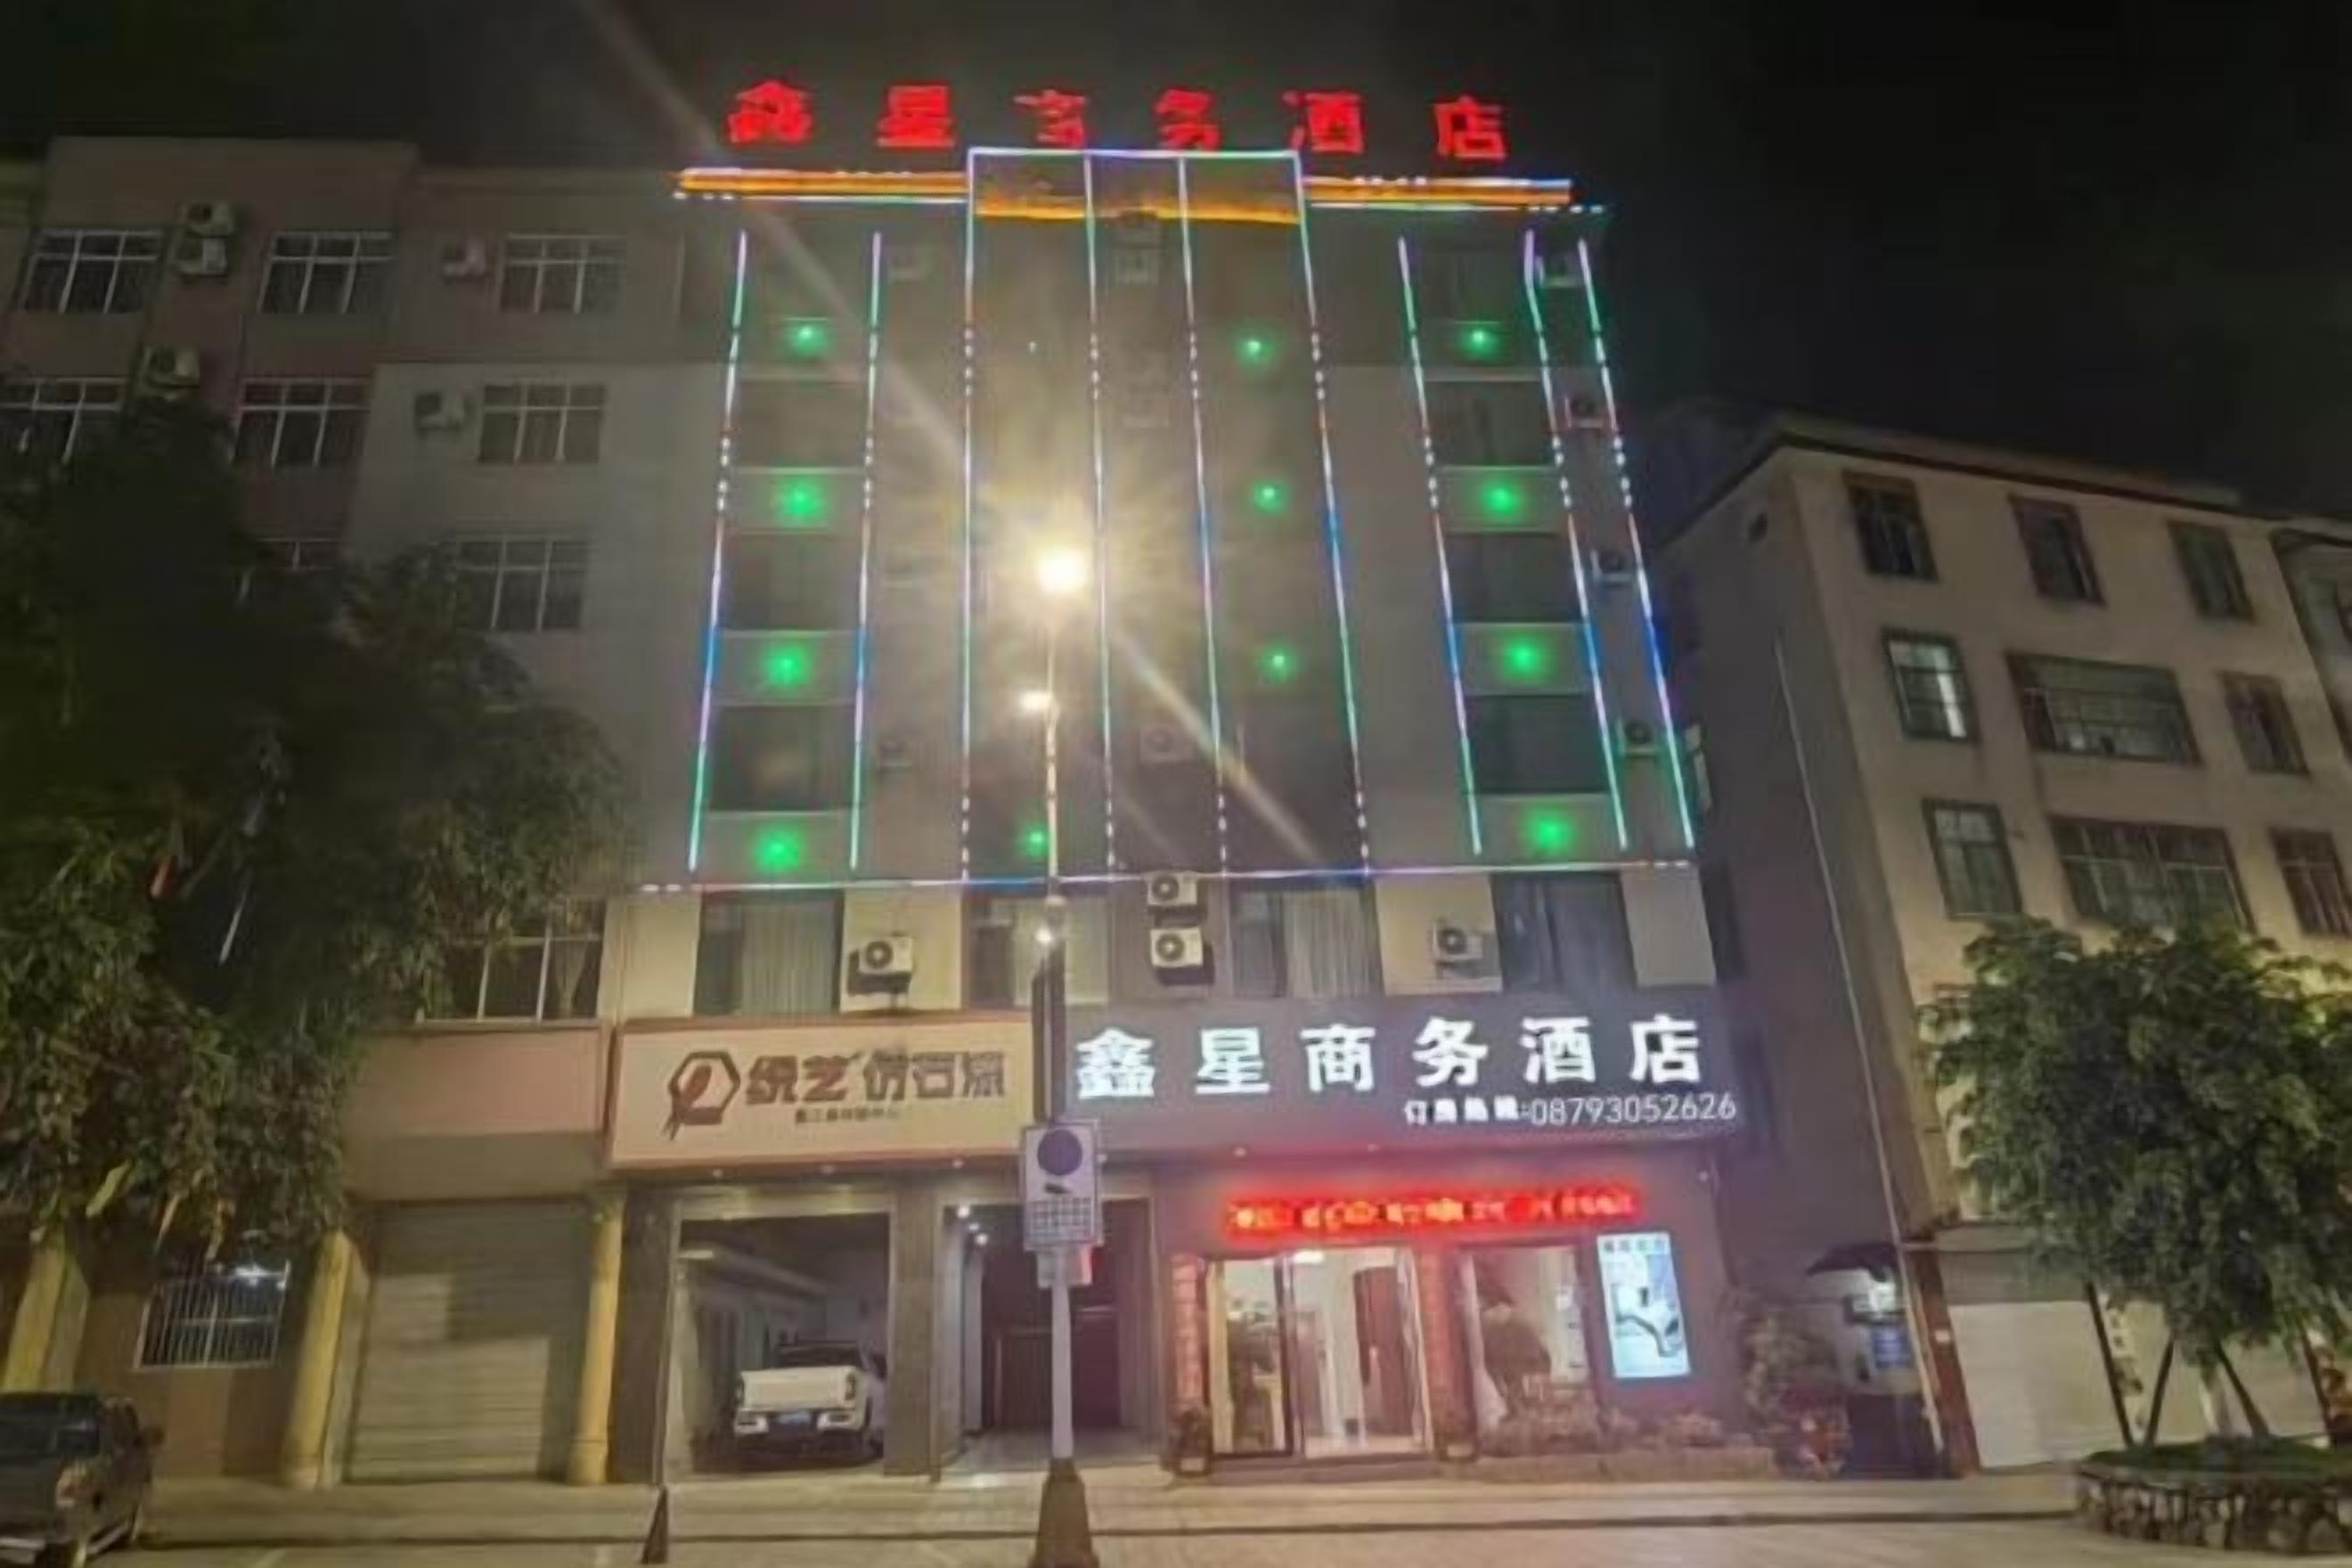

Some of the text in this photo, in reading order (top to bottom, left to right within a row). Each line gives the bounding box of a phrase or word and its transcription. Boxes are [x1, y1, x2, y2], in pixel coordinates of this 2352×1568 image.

[1075, 1014, 1703, 1099] 鑫星商务酒店
